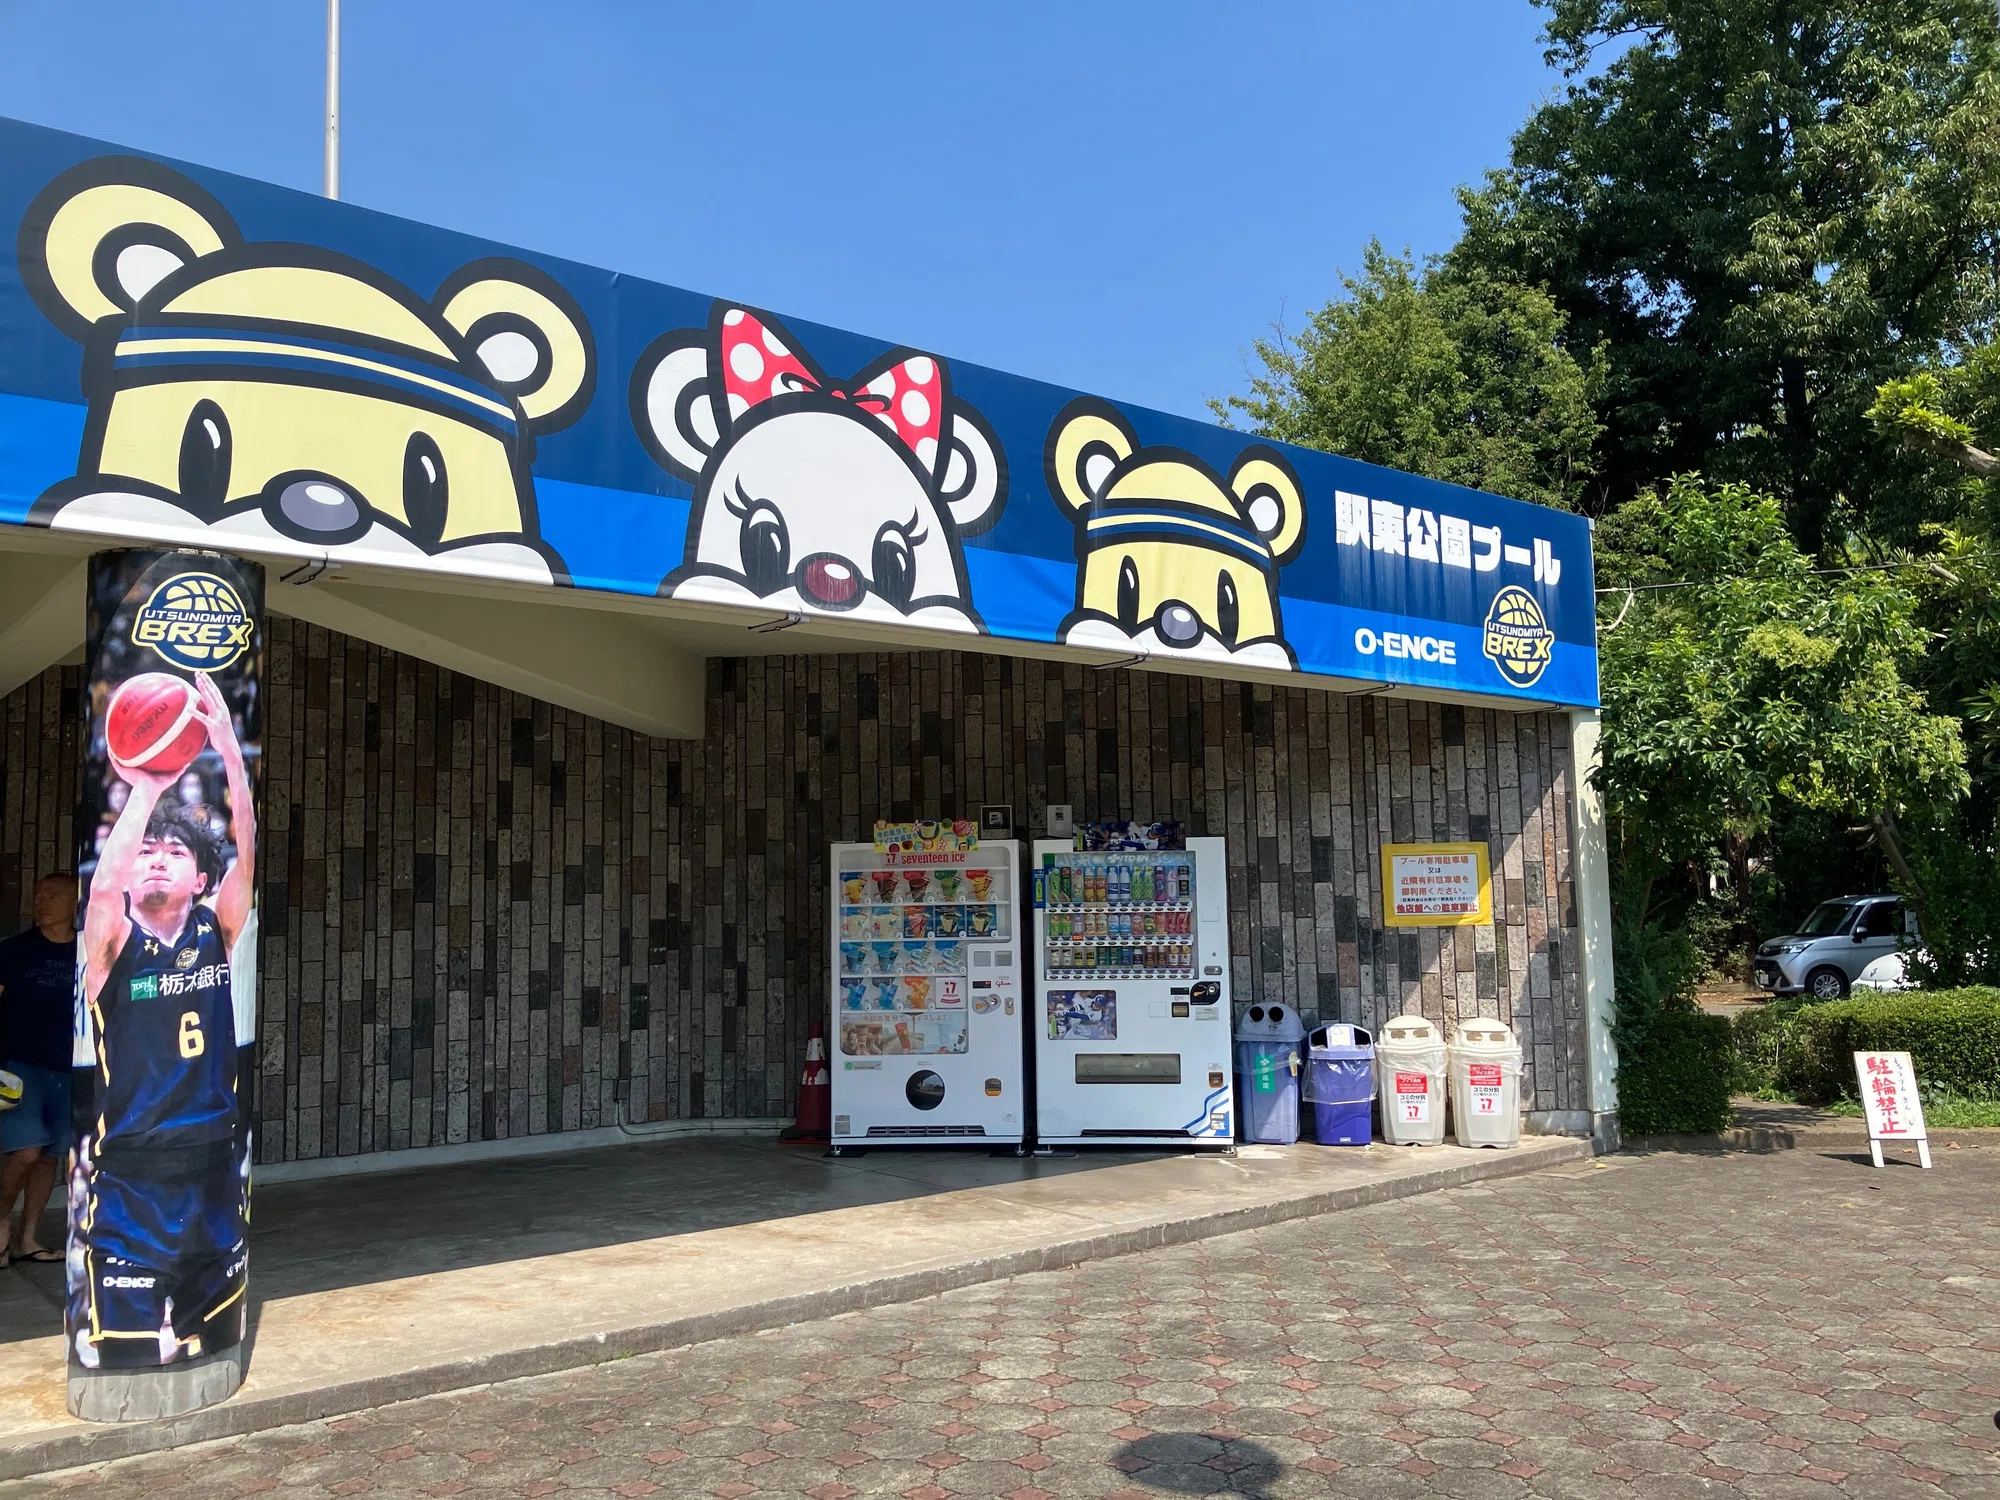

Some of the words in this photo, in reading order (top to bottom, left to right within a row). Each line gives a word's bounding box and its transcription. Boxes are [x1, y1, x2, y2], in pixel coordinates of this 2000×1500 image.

[1335, 490, 1561, 585] 駅東公園プール
[144, 608, 242, 624] UTSUNOMIYA
[138, 621, 250, 645] BREX
[1488, 621, 1543, 637] UTSUNOMIYA
[1354, 628, 1457, 665] O-ENCE
[1485, 632, 1551, 660] BREX
[901, 853, 949, 865] seventeen
[951, 851, 965, 863] ice
[1136, 854, 1149, 862] EN
[179, 1011, 205, 1059] 6
[1866, 1056, 1907, 1135] 駐輪禁止
[102, 1276, 156, 1289] O-ENCE
